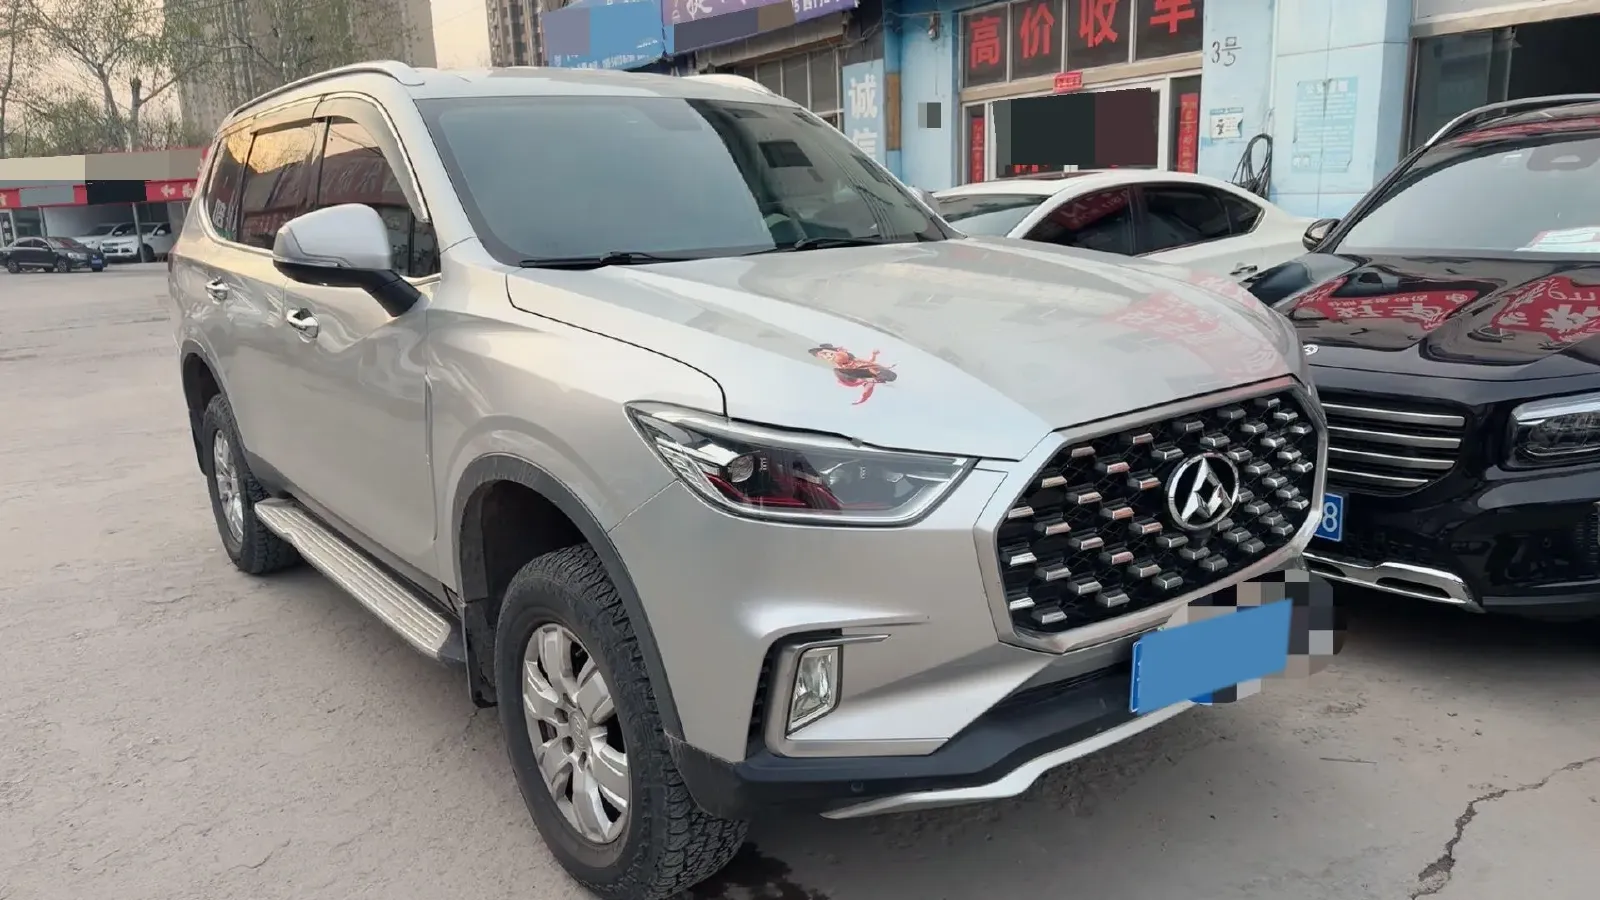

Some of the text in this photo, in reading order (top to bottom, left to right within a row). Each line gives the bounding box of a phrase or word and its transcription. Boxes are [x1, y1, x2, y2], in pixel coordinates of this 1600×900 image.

[970, 0, 1196, 68] 高价收车
[1211, 36, 1242, 67] 3号
[1322, 501, 1338, 533] 8
